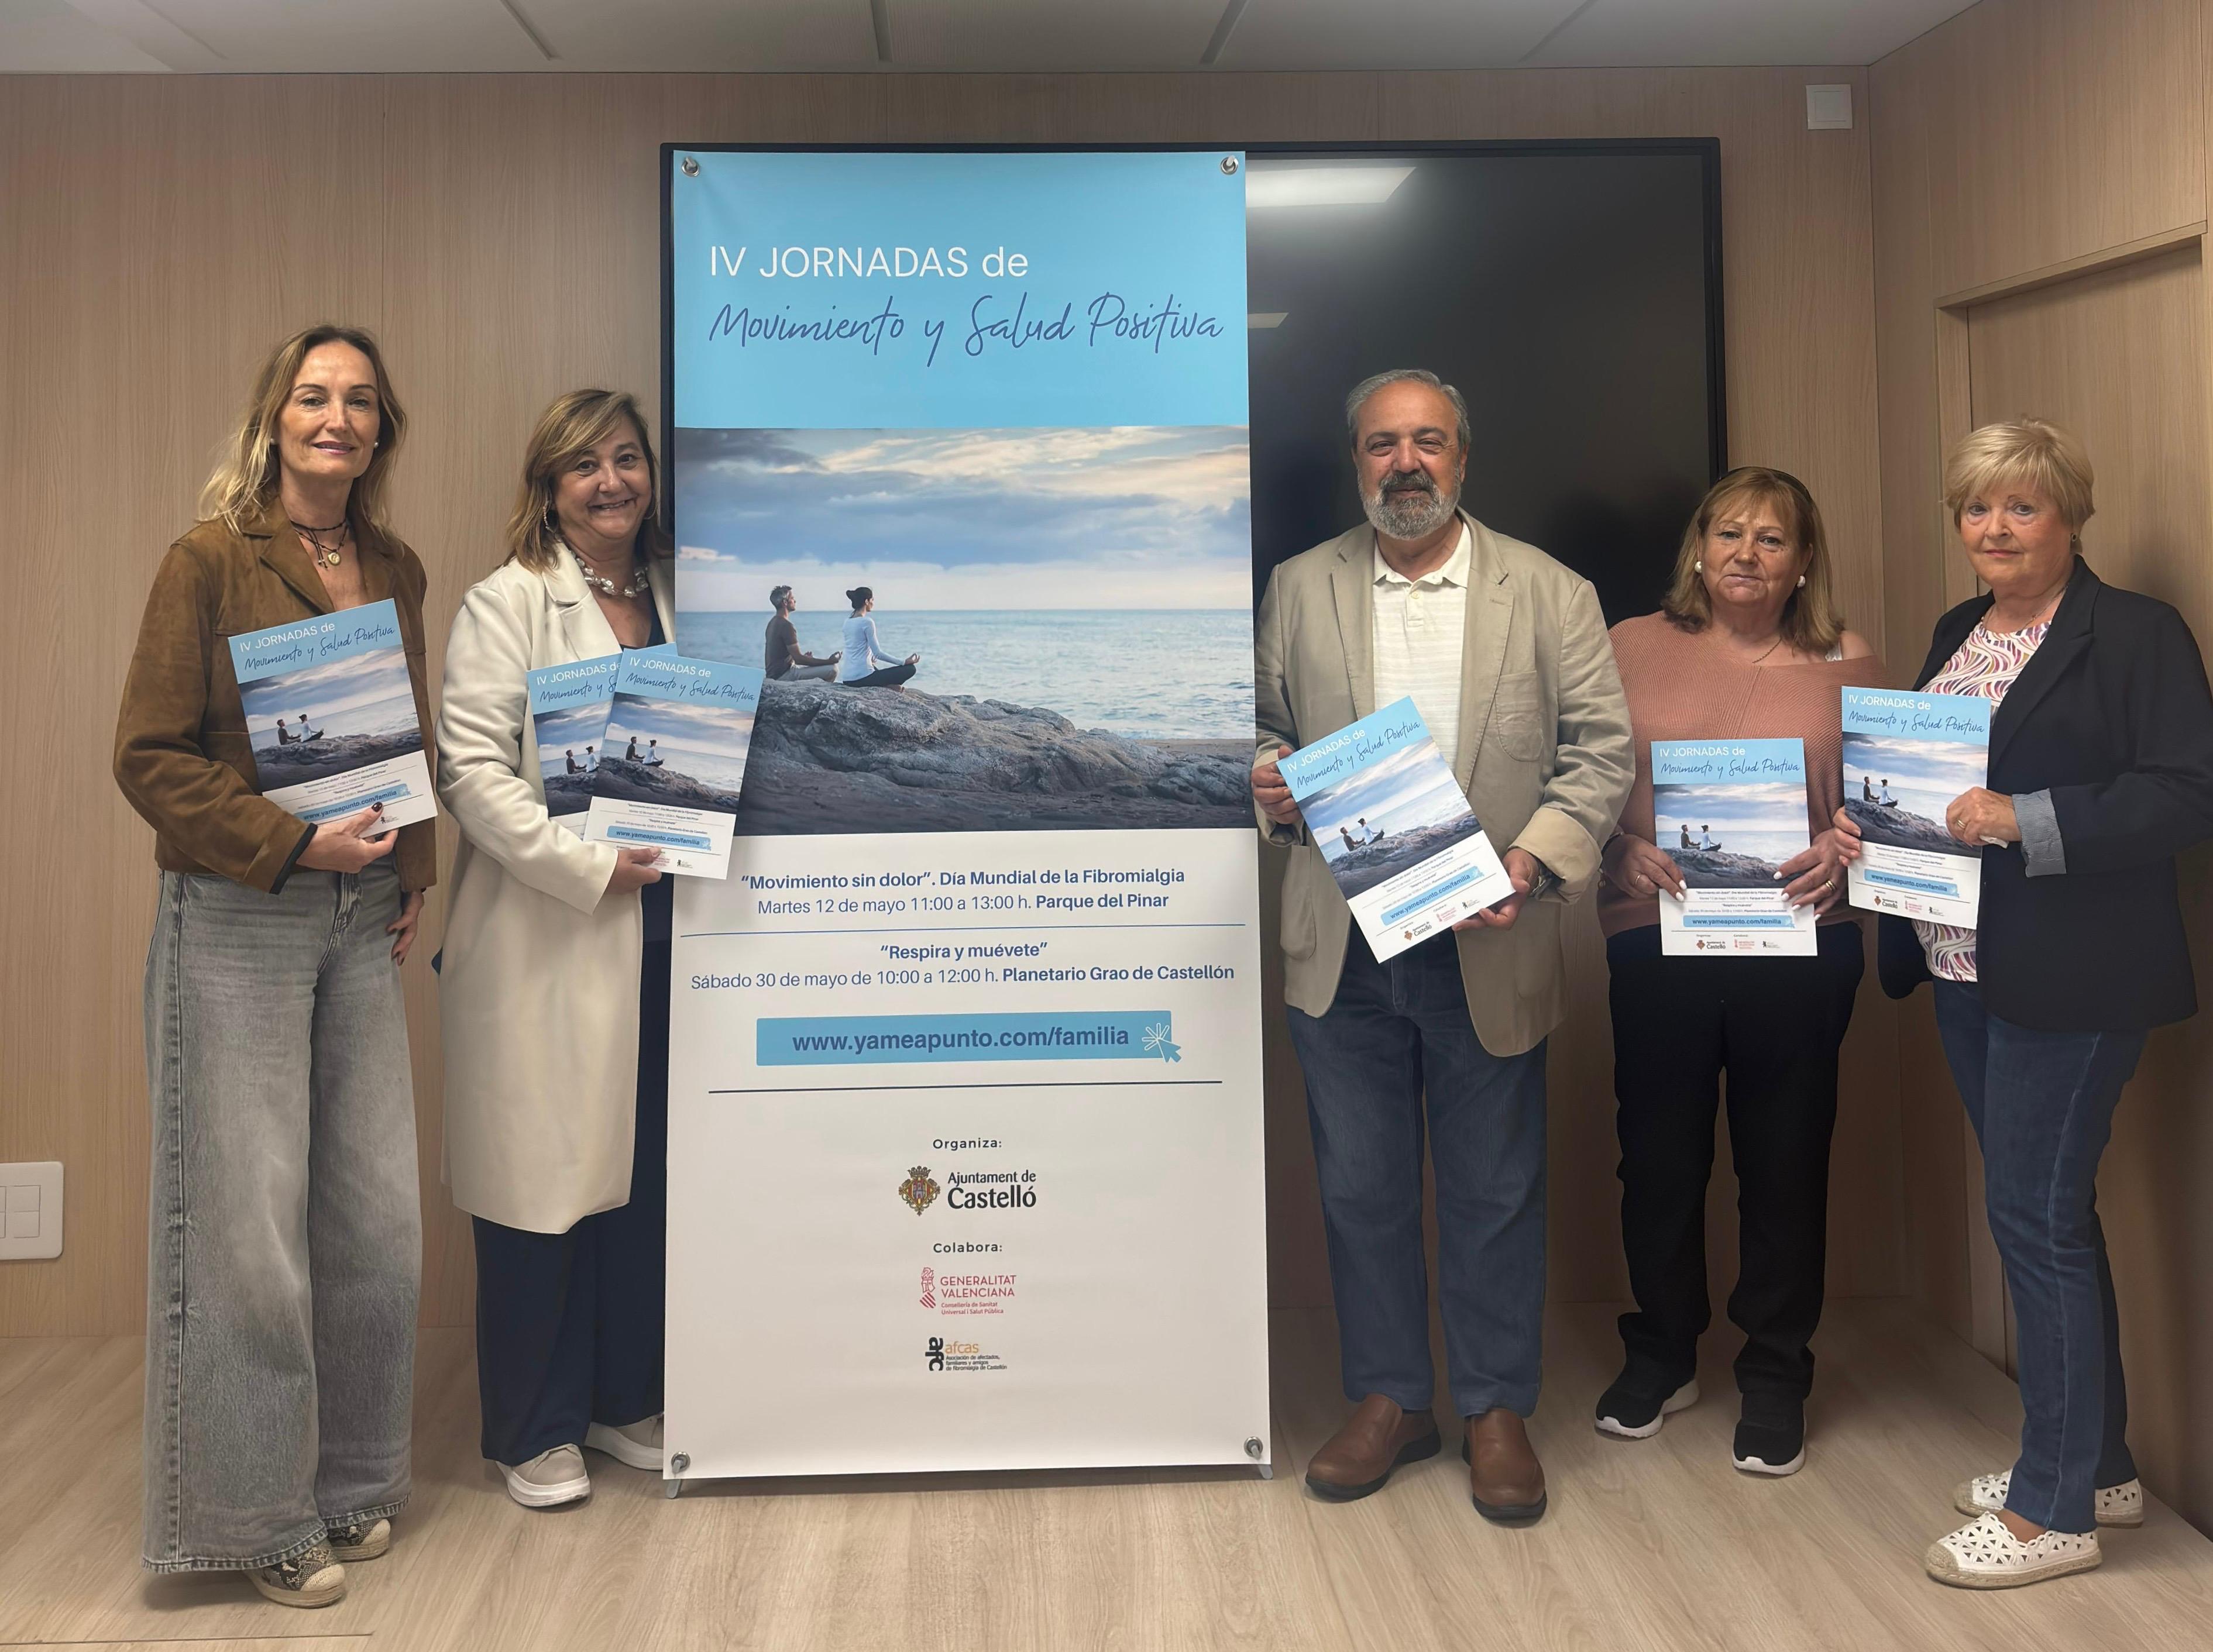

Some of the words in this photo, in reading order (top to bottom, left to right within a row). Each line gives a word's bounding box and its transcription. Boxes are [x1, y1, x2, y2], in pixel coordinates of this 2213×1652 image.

[712, 246, 746, 276] IV
[760, 247, 968, 277] JORNADAS
[982, 246, 1028, 277] de
[709, 295, 904, 355] Movimiento
[925, 320, 944, 367] y
[965, 292, 1075, 356] Salud
[1088, 292, 1224, 353] Positiva
[240, 641, 250, 652] IV
[255, 625, 317, 648] JORNADAS
[321, 622, 335, 632] de
[245, 644, 302, 670] Movimiento
[307, 648, 313, 662] y
[320, 633, 352, 656] Salud
[354, 624, 394, 644] Positiva
[537, 675, 547, 685] IV
[551, 663, 606, 682] JORNADAS
[630, 657, 640, 666] IV
[642, 660, 696, 674] JORNADAS
[698, 669, 710, 677] de
[539, 680, 592, 702] Movimiento
[597, 684, 602, 697] y
[626, 672, 676, 691] Movimiento
[679, 684, 686, 697] y
[689, 680, 719, 696] Salud
[720, 684, 754, 702] Positiva
[1848, 694, 1858, 703] IV
[1860, 696, 1914, 708] JORNADAS
[1917, 700, 1930, 710] de
[1848, 710, 1896, 728] Movimiento
[1901, 719, 1907, 732] y
[1911, 713, 1941, 731] Salud
[1945, 715, 1984, 735] Positiva
[1287, 760, 1297, 772] IV
[1301, 735, 1351, 766] JORNADAS
[1352, 729, 1365, 739] de
[1297, 755, 1343, 788] Movimiento
[1346, 755, 1353, 769] y
[1356, 735, 1383, 761] Salud
[1384, 721, 1420, 744] Positiva
[1660, 748, 1669, 756] IV
[1672, 746, 1729, 756] JORNADAS
[1732, 746, 1745, 755] de
[1660, 760, 1712, 776] Movimiento
[1717, 766, 1723, 779] y
[1729, 758, 1758, 776] Salud
[1761, 758, 1799, 774] Positiva
[616, 831, 699, 845] www.yameapunto.com/familia
[741, 875, 848, 889] “Movimiento
[852, 873, 875, 887] sin
[879, 872, 935, 886] dolor”.
[940, 872, 965, 885] Día
[971, 870, 1036, 884] Mundial
[1040, 870, 1060, 883] de
[1065, 870, 1078, 883] la
[1084, 869, 1184, 886] Fibromialgia
[759, 901, 810, 914] Martes
[816, 899, 834, 913] 12
[839, 899, 858, 912] de
[864, 901, 905, 914] mayo
[912, 897, 953, 910] 11:00
[958, 900, 965, 910] a
[972, 896, 1013, 909] 13:00
[1019, 895, 1031, 908] h.
[1037, 896, 1094, 911] Parque
[1098, 894, 1123, 907] del
[1128, 894, 1169, 907] Pinar
[1390, 875, 1470, 918] www.yameapunto.com/familia
[881, 945, 950, 962] “Respira
[954, 948, 964, 961] y
[968, 942, 1047, 957] muévete”
[692, 973, 751, 989] Sábado
[756, 973, 775, 987] 30
[780, 972, 800, 986] de
[805, 975, 847, 989] mayo
[851, 971, 871, 985] de
[878, 970, 919, 984] 10:00
[924, 973, 932, 983] a
[939, 969, 980, 983] 12:00
[985, 968, 998, 982] h.
[1004, 967, 1085, 981] Planetario
[1090, 967, 1129, 980] Grao
[1133, 966, 1153, 979] de
[1158, 965, 1233, 979] Castellón
[792, 1026, 1128, 1055] www.yameapunto.com/familia
[933, 1138, 1001, 1151] Organiza:
[948, 1172, 1019, 1186] Ajuntament
[1022, 1169, 1036, 1182] de
[948, 1184, 1036, 1209] Castelló
[933, 1242, 1002, 1252] Colabora:
[940, 1275, 1016, 1286] GENERALITAT
[941, 1288, 1015, 1297] VALENCIANA
[945, 1341, 978, 1354] afcas
